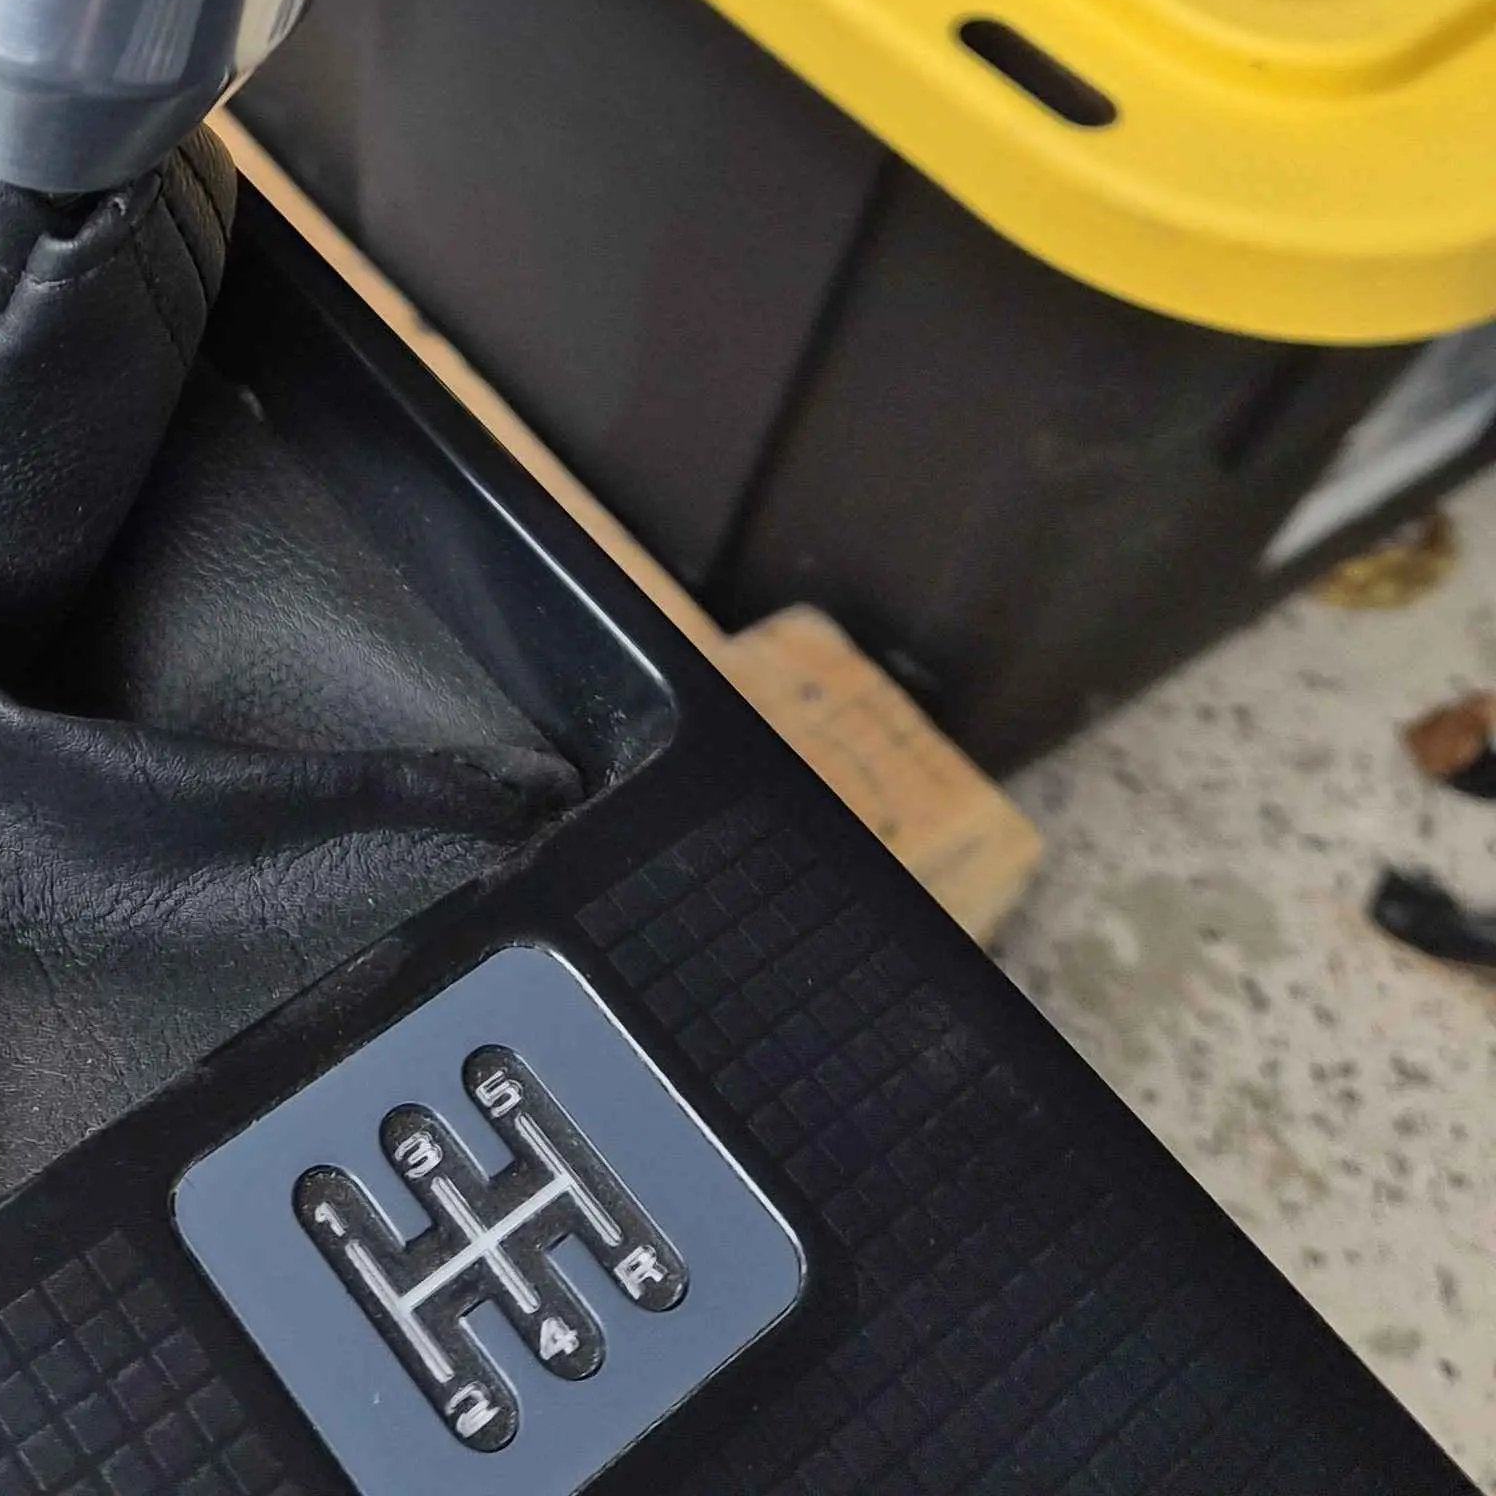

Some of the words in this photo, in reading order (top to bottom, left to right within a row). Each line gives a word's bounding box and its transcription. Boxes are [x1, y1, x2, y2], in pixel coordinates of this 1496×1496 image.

[474, 1070, 523, 1118] 5
[394, 1131, 444, 1179] 3
[313, 1202, 347, 1237] 1
[614, 1244, 668, 1300] R
[538, 1316, 581, 1361] 4
[445, 1382, 499, 1438] 2
